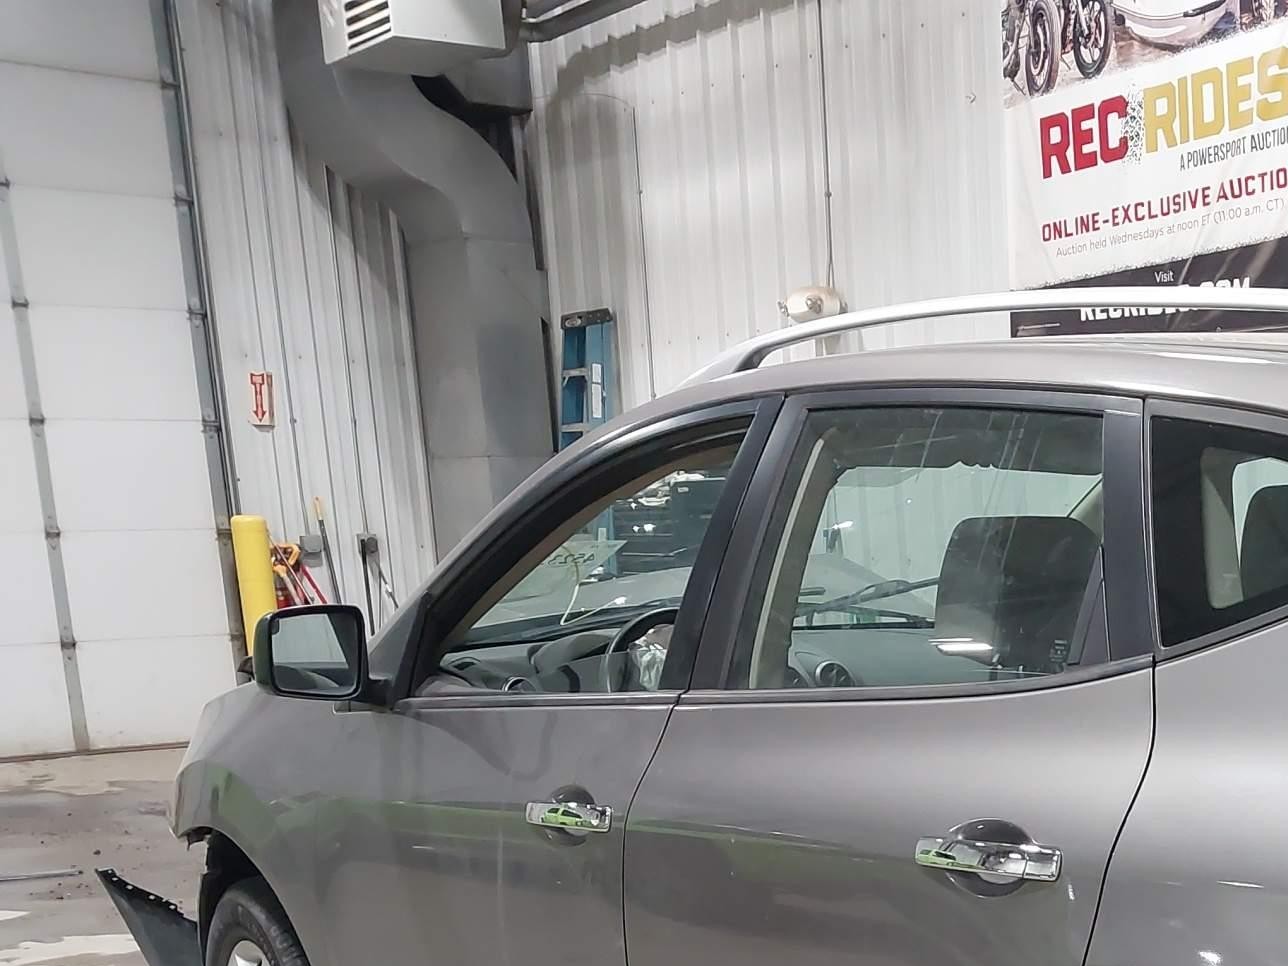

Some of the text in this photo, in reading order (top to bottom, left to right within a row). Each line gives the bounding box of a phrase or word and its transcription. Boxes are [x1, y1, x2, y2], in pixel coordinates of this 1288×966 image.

[1040, 95, 1128, 180] REC
[1180, 153, 1186, 171] A
[1187, 136, 1246, 169] POWERSPORT
[1042, 186, 1211, 242] ONLINE-EXCLUSIVE
[1056, 243, 1087, 257] Auction
[1090, 237, 1107, 249] held
[1109, 227, 1163, 247] Wednesdays
[1167, 224, 1175, 234] at
[1177, 219, 1199, 231] noon
[1266, 198, 1284, 212] CT)
[1154, 270, 1174, 283] Visit
